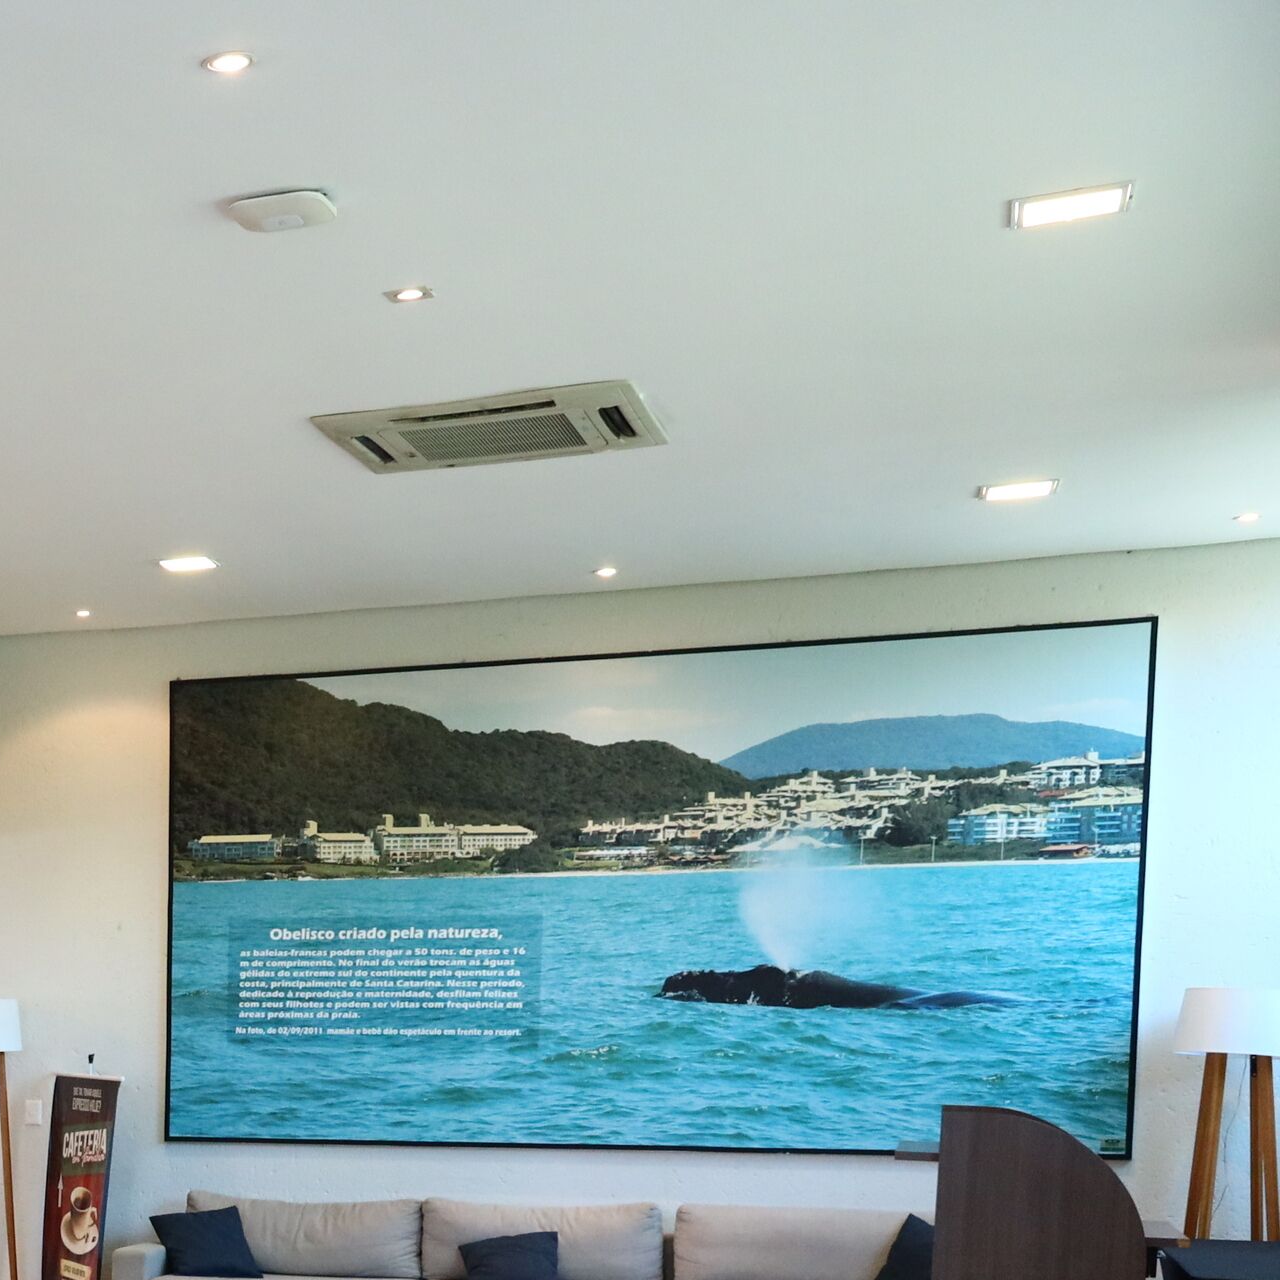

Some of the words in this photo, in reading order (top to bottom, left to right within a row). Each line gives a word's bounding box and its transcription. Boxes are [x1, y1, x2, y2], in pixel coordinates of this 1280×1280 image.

[270, 928, 334, 941] Obelisco
[338, 928, 387, 940] criado
[391, 927, 424, 942] pela
[428, 928, 503, 940] natureza,
[329, 949, 365, 958] podem
[367, 948, 404, 958] chegar
[475, 949, 500, 957] peso
[513, 947, 526, 955] 16
[266, 960, 336, 968] comprimento.
[338, 959, 353, 967] No
[483, 959, 516, 968] águas
[240, 970, 275, 979] gélidas
[430, 969, 452, 978] pela
[455, 970, 504, 978] quentura
[270, 980, 348, 989] principalmente
[480, 979, 525, 989] período,
[296, 991, 353, 999] reprodução
[365, 991, 434, 999] maternidade,
[436, 990, 482, 998] desfilam
[484, 990, 518, 998] felizes
[335, 1001, 370, 1009] podem
[447, 1001, 504, 1010] frequência
[268, 1011, 314, 1020] próximas
[332, 1011, 361, 1020] praia.
[278, 1027, 323, 1035] 02/09/2011
[400, 1029, 441, 1037] espetáculo
[62, 1128, 107, 1159] CAFETERIA
